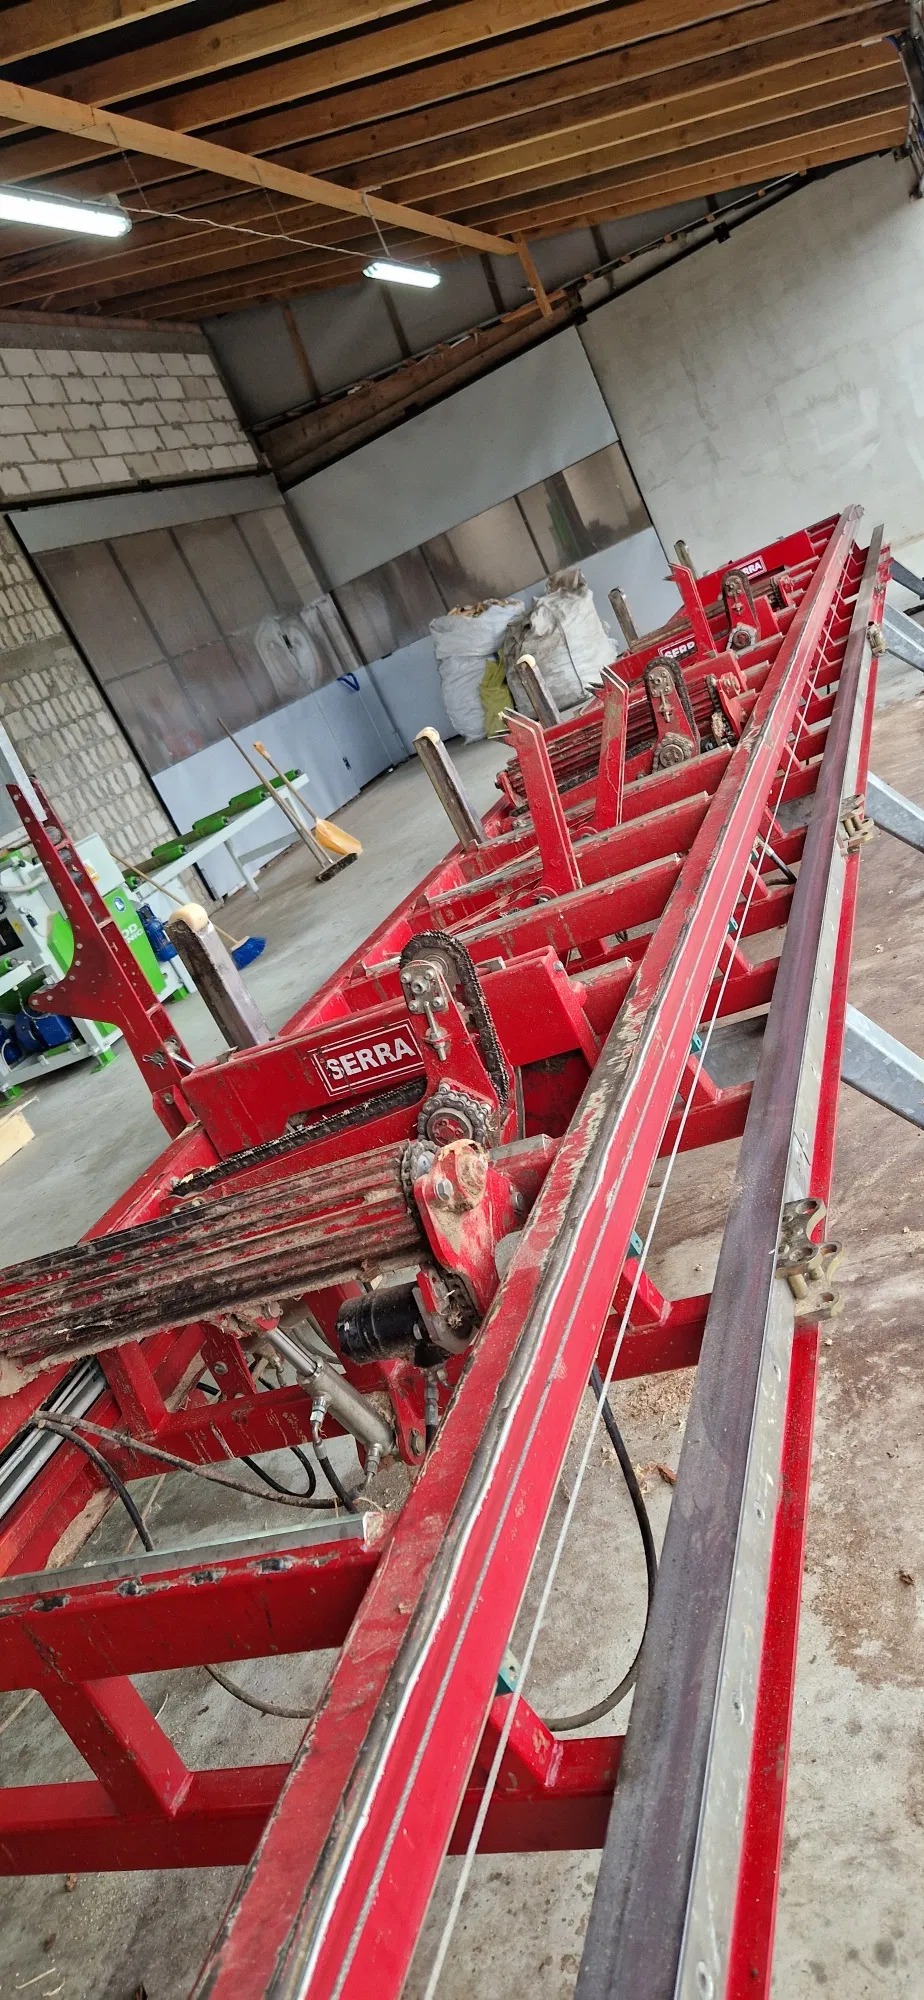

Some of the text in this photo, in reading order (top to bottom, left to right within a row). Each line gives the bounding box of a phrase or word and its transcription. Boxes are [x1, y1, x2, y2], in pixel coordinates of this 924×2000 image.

[740, 562, 763, 575] RRA
[664, 641, 696, 659] SERR
[121, 923, 138, 939] OD
[326, 1037, 416, 1080] SERRA
